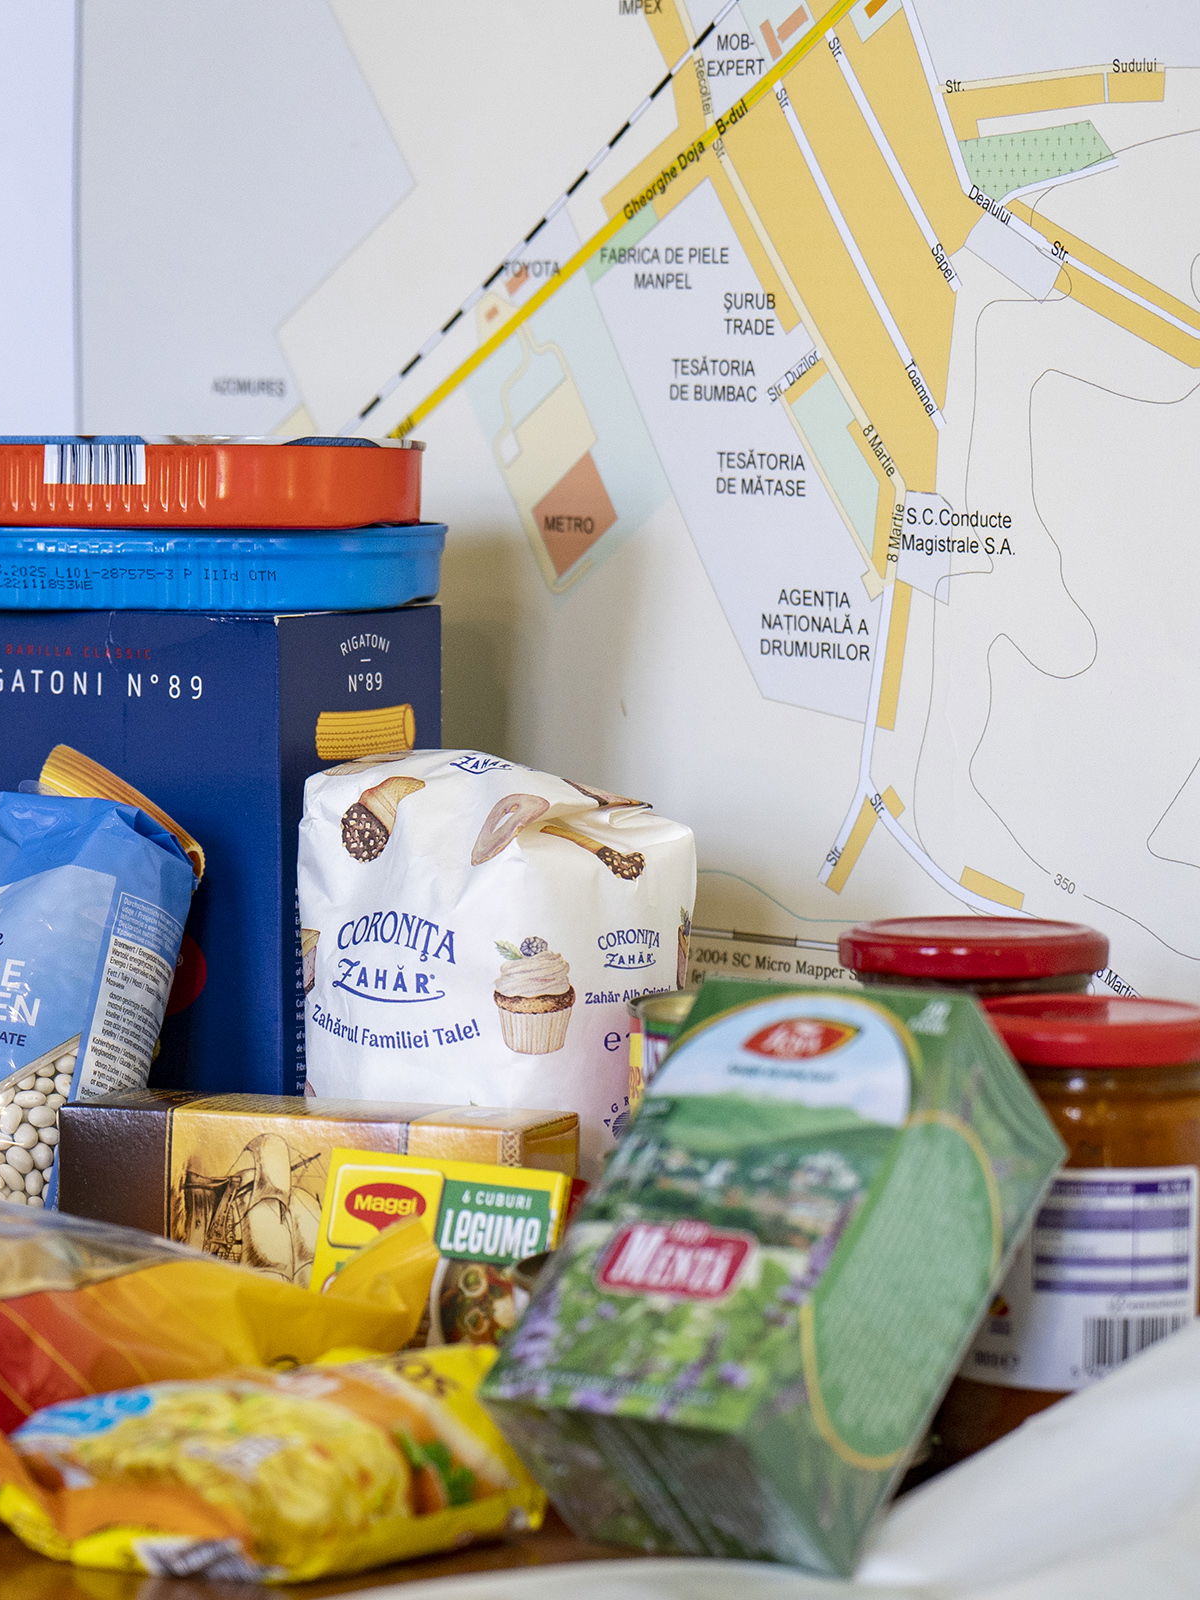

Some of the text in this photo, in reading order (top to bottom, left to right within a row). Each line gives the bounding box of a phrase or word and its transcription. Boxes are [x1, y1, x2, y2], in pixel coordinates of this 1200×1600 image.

[717, 34, 754, 50] MOB-
[828, 37, 841, 62] Str.
[707, 59, 765, 77] EXPERT
[1112, 58, 1157, 73] Sudului
[945, 79, 966, 94] Str.
[775, 87, 789, 113] Str.
[623, 98, 749, 220] Gheorghe Doja B-dul
[968, 184, 1013, 226] Dealului
[600, 247, 729, 264] FABRICA DE PIELE
[931, 243, 957, 283] Sapei
[1051, 240, 1069, 264] Str.
[503, 260, 561, 277] TOYOTA
[634, 273, 692, 289] MANPEL
[724, 318, 775, 335] TRADE
[784, 350, 821, 387] Duzilor
[669, 384, 757, 403] DE BUMBAC
[905, 358, 936, 417] Toamnei
[862, 424, 896, 477] 8 Martie
[716, 475, 806, 497] DE MĂTASE
[543, 515, 595, 535] METRO
[886, 503, 905, 563] 8 Martie
[901, 533, 1016, 556] Magistrale S.A.
[857, 619, 869, 635] A
[5, 643, 73, 657] BARILLA
[339, 632, 391, 657] RIGATONI
[760, 639, 870, 661] DRUMURILOR
[870, 793, 885, 819] Str.
[826, 845, 846, 869] Str.
[1052, 873, 1077, 896] 350
[696, 949, 728, 964] 2004
[732, 953, 751, 968] SC
[755, 956, 790, 973] Micro
[796, 960, 845, 981] Mapper
[584, 990, 621, 1005] Zahăr
[312, 1004, 480, 1049] Zahărul Familiei Tale!
[354, 1194, 417, 1217] Maggi
[475, 1190, 533, 1211] CUBURI
